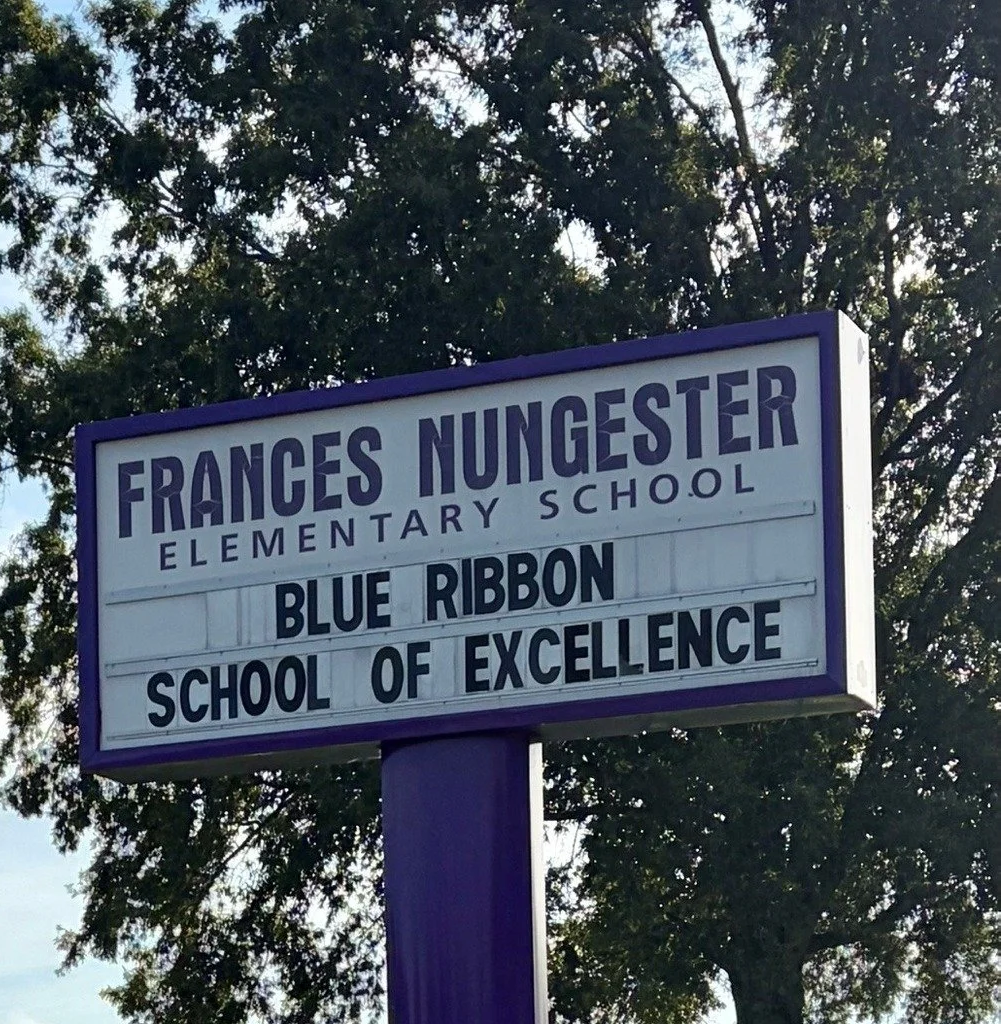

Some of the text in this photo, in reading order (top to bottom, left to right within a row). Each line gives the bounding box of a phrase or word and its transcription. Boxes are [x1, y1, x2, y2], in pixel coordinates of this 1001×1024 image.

[117, 364, 799, 539] FRANCES NUNGESTER
[159, 463, 755, 571] ELEMENTARY SCHOOL
[275, 541, 615, 640] BLUE RIBBON
[146, 601, 782, 728] SCHOOL OF EXCELLENCE
